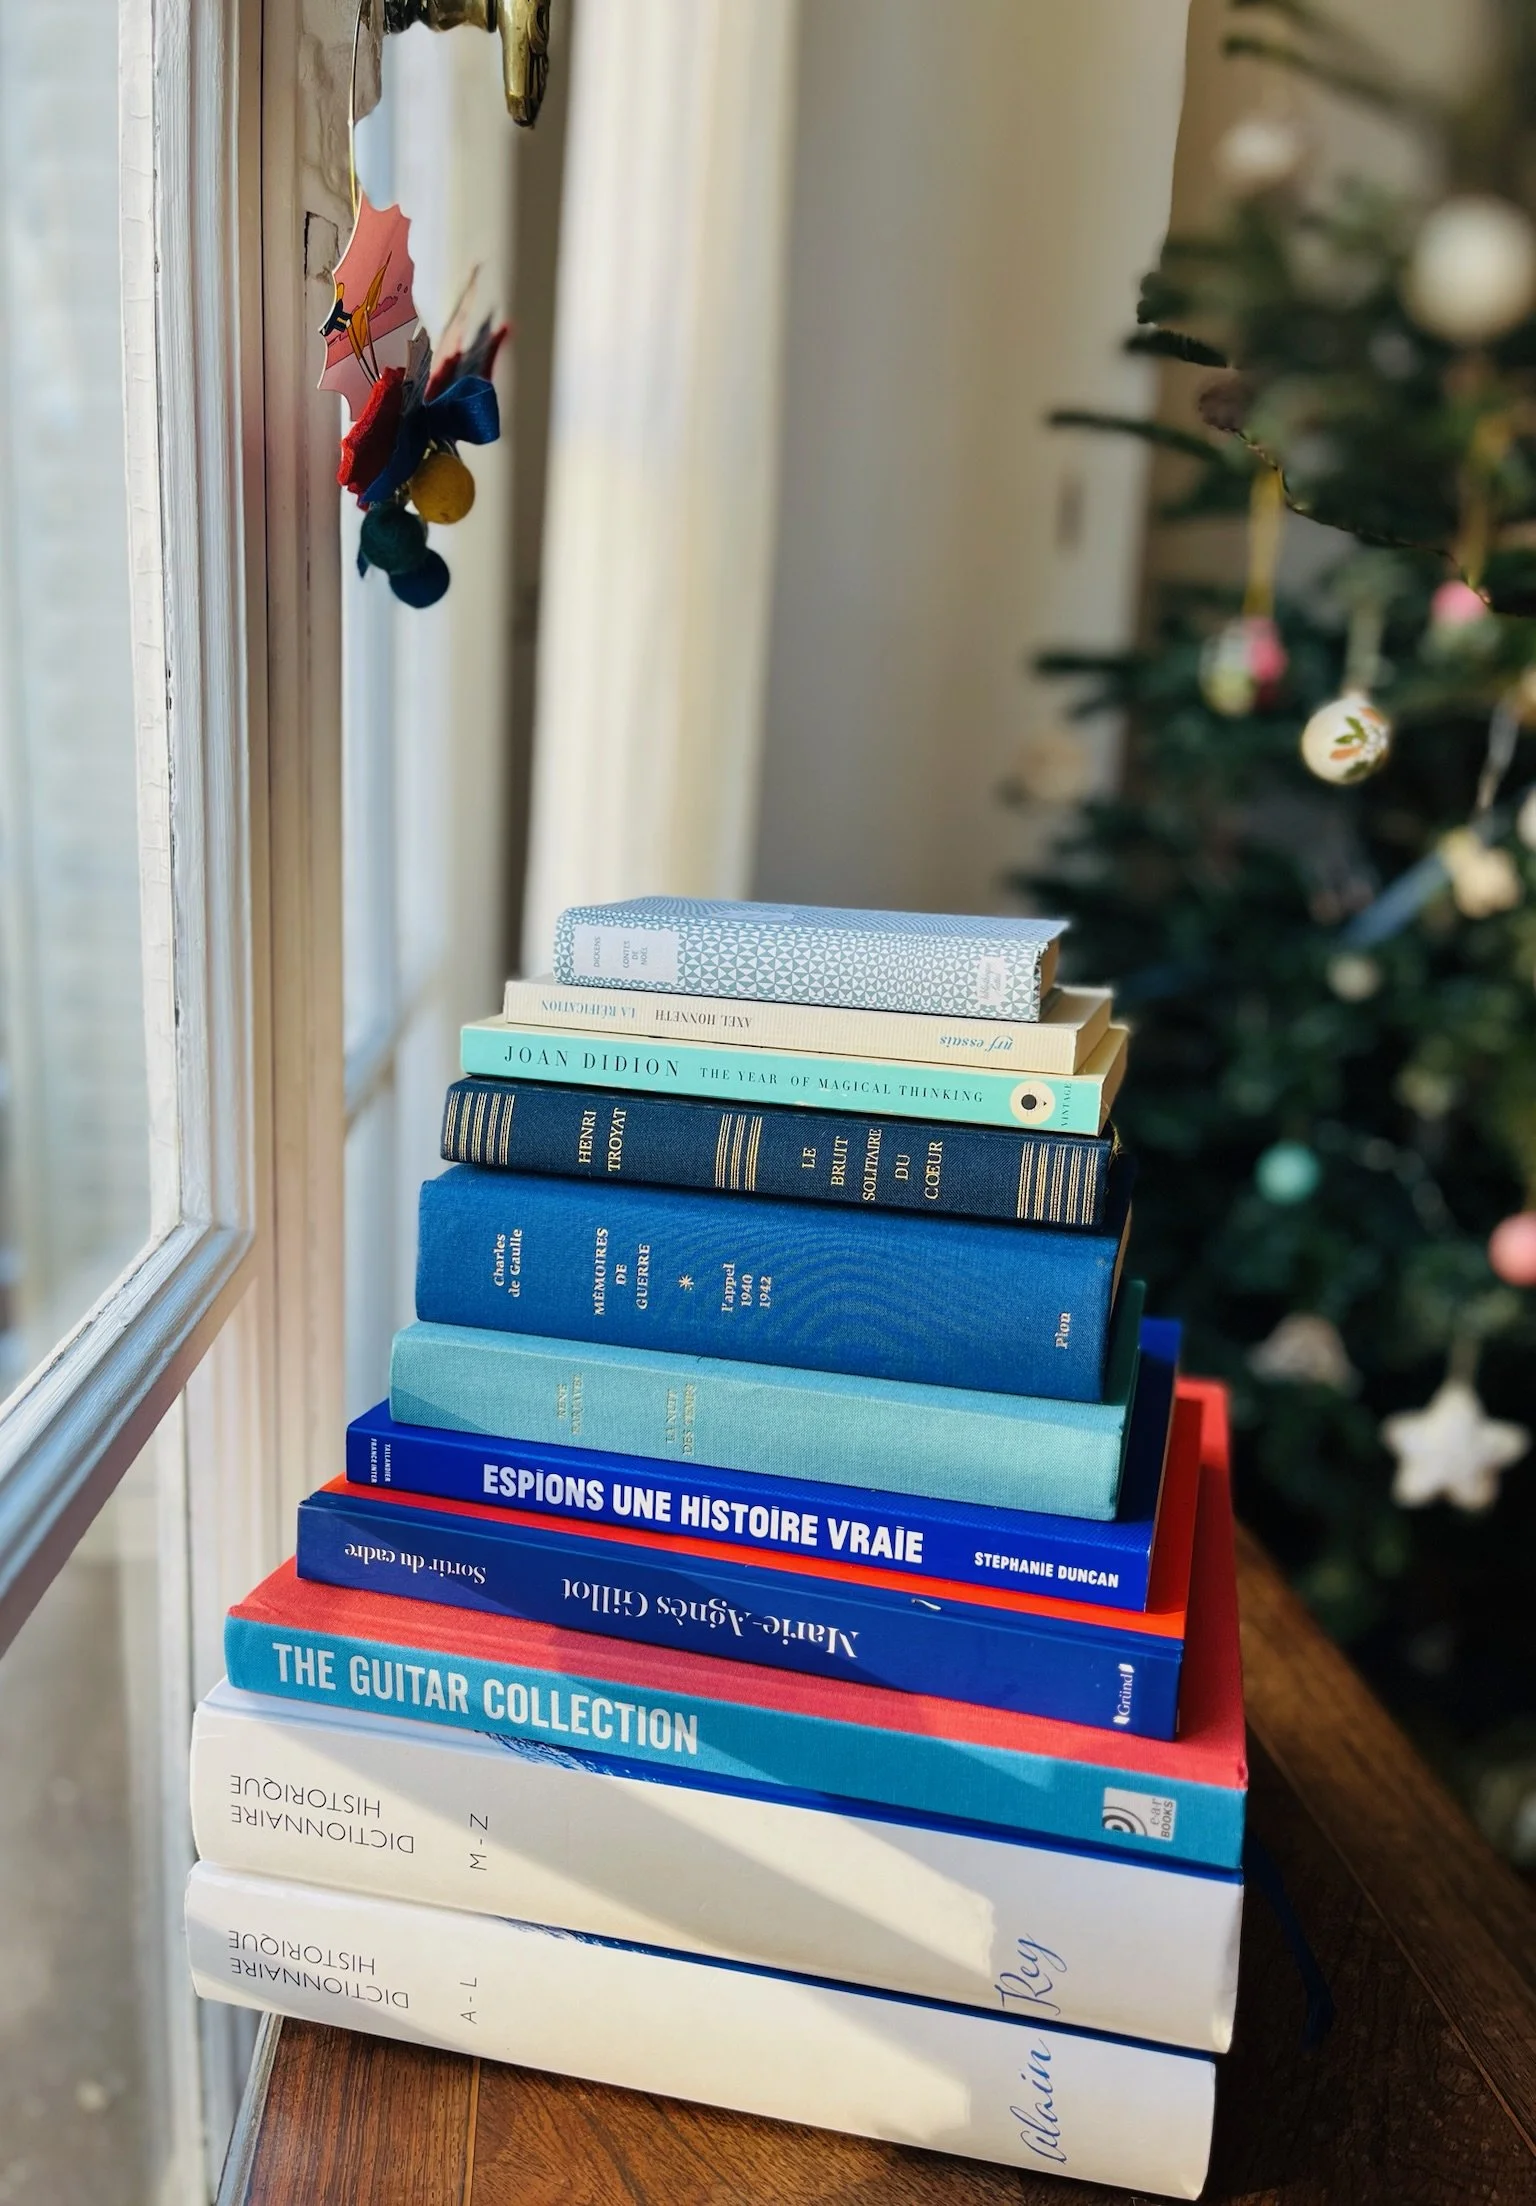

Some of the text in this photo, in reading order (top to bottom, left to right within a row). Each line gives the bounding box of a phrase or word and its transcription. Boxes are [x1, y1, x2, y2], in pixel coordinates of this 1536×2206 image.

[622, 1006, 637, 1018] LA
[655, 1009, 753, 1028] AXEL HONNETH
[504, 1045, 680, 1077] JOAN DIDION
[939, 1033, 984, 1049] essais
[700, 1067, 983, 1103] THE YEAR OF MAGICAL THINKING
[578, 1109, 597, 1163] HENRI
[607, 1107, 627, 1172] TROYAT
[801, 1147, 817, 1169] LE
[831, 1135, 849, 1186] BRUIT
[862, 1128, 882, 1202] SOLITAIRE
[894, 1154, 911, 1181] DU
[493, 1233, 506, 1287] Charles
[508, 1228, 522, 1298] de Gaulle
[615, 1263, 627, 1285] DE
[636, 1243, 650, 1310] GUERRE
[740, 1273, 753, 1308] 1940
[759, 1275, 772, 1309] 1942
[1055, 1312, 1071, 1349] Plon
[612, 1483, 671, 1522] UNE
[344, 1543, 487, 1585] Sortir du cadre
[1057, 1564, 1119, 1589] DUNCAN
[561, 1578, 860, 1658] Marie-Agnès Gillot
[272, 1642, 699, 1756] THE GUITAR COLLECTION
[1117, 1673, 1133, 1716] Gründ
[230, 1774, 381, 1818] HISTORIQUE
[231, 1804, 414, 1854] DICTIONNAIRE
[1160, 1800, 1173, 1838] BOOKS
[228, 1930, 375, 1976] HISTORIQUE
[230, 1957, 409, 2009] DICTIONNAIRE
